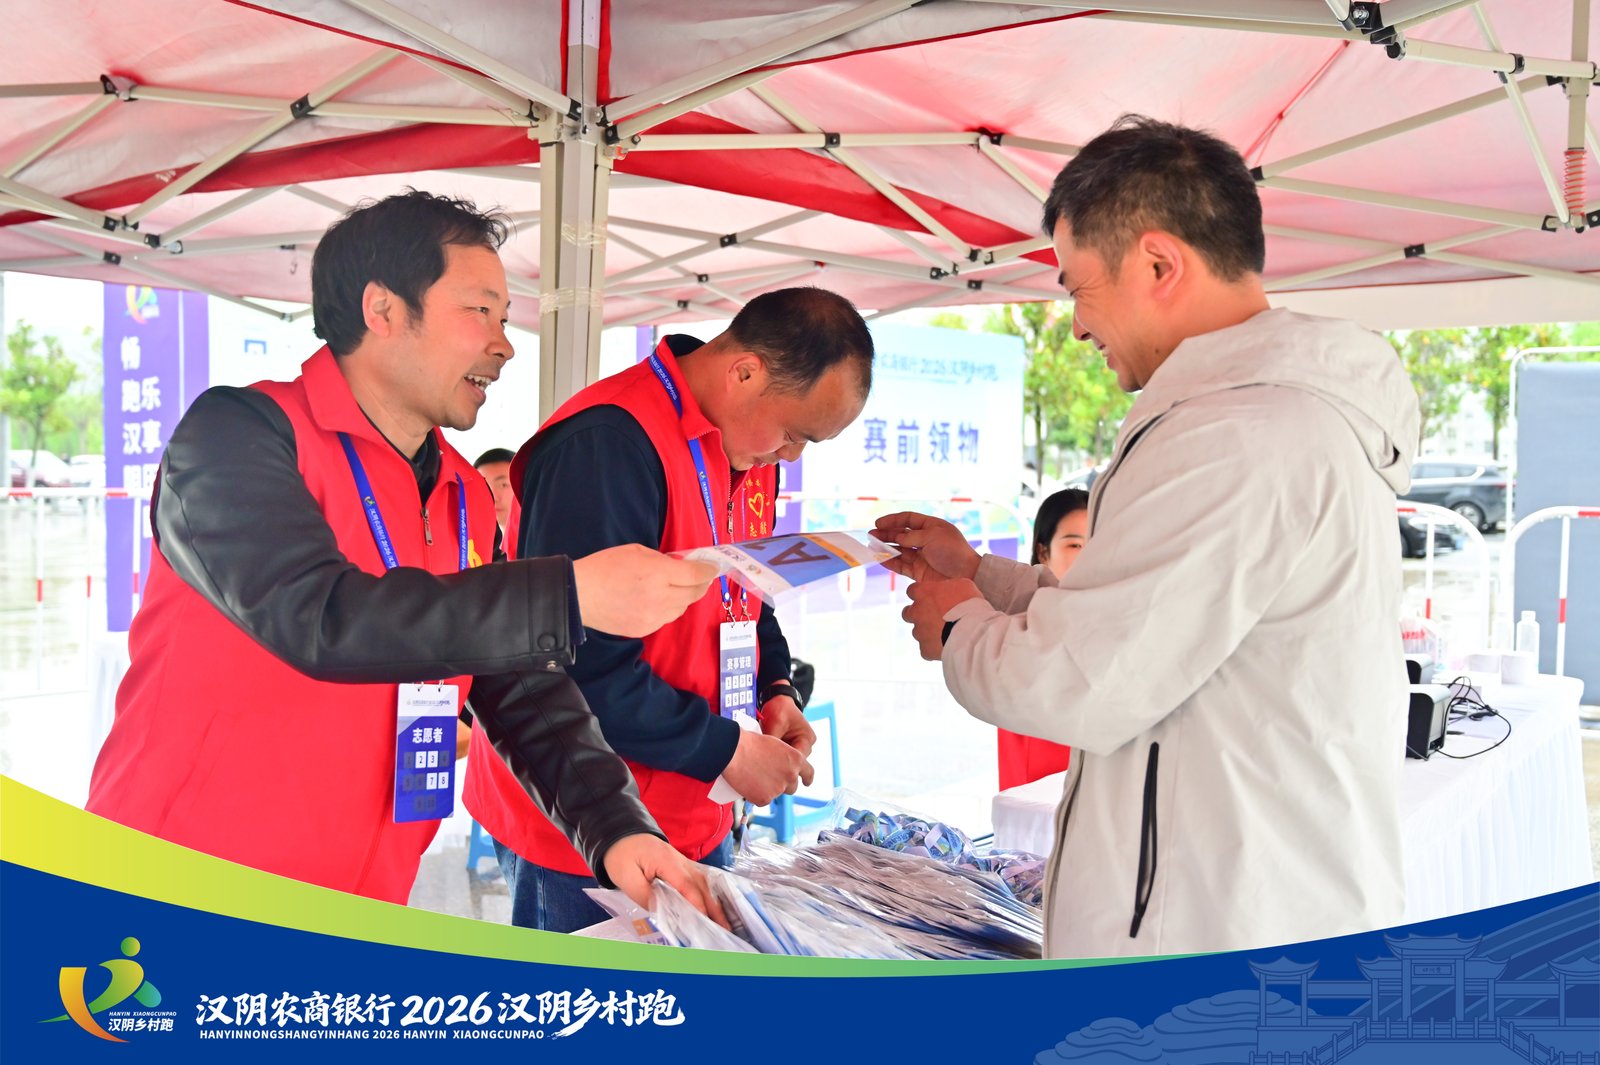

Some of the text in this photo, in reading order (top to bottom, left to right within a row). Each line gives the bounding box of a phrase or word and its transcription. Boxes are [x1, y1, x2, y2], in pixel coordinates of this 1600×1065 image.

[864, 417, 979, 463] 赛前领物
[412, 727, 443, 744] 志愿者
